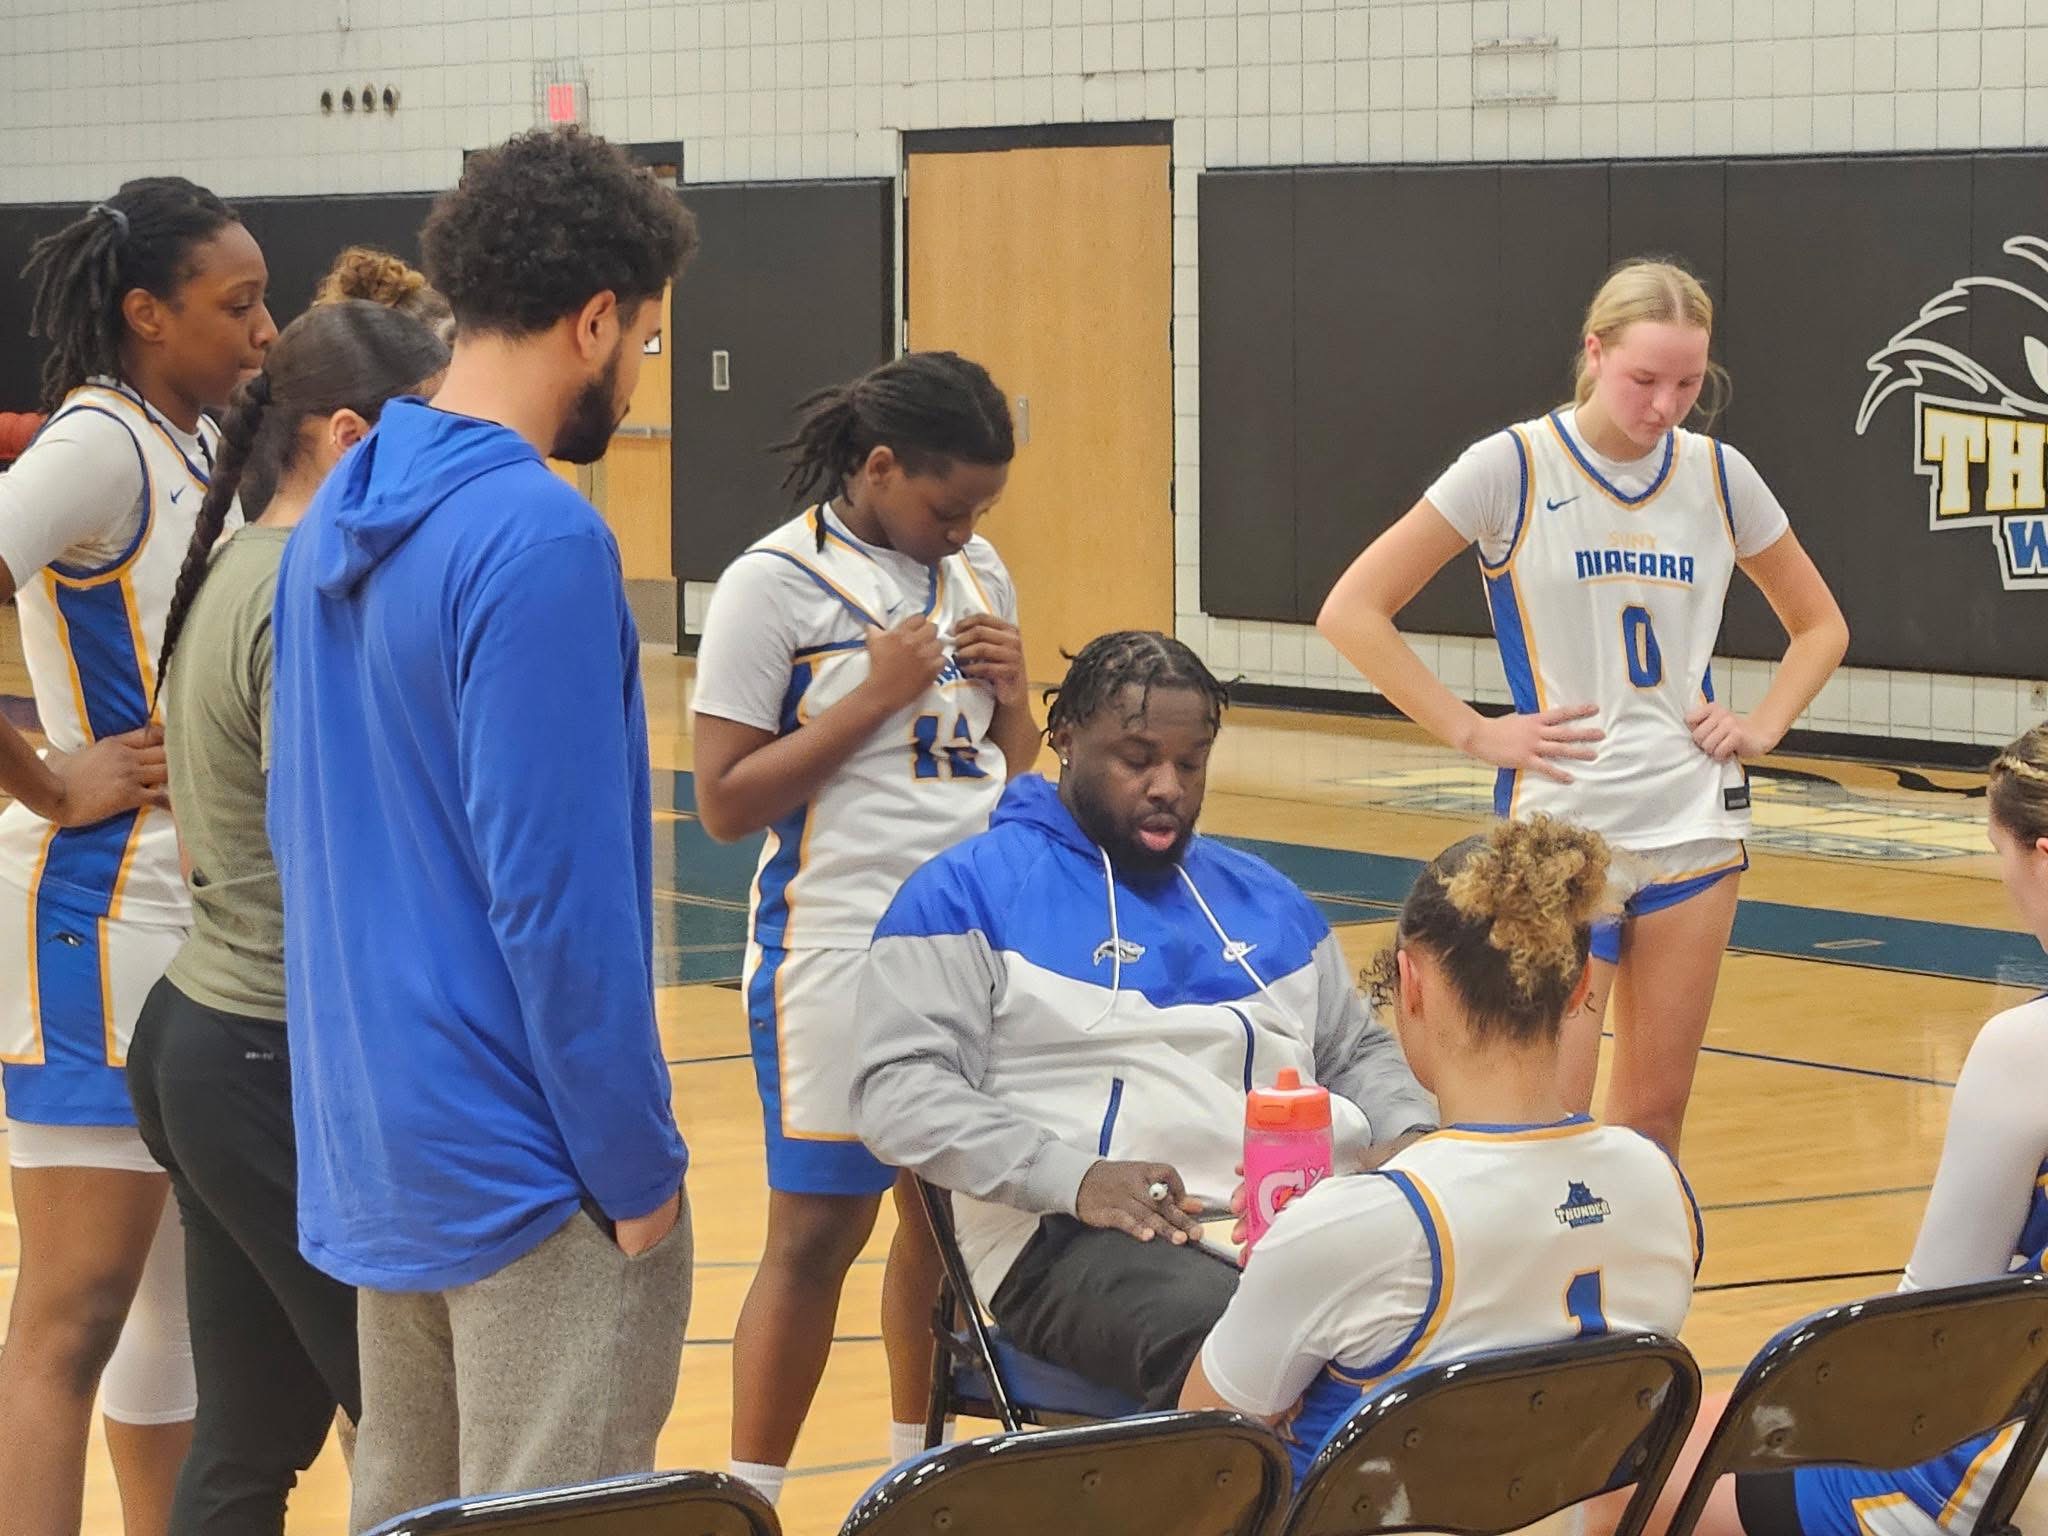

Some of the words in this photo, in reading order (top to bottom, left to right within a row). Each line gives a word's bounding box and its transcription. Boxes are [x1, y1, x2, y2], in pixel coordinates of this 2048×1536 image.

[1923, 407, 2048, 516] TH
[1575, 549, 1694, 584] NIAGARA
[1620, 604, 1664, 690] 0
[1555, 1201, 1611, 1224] THUNDER
[1564, 1267, 1610, 1337] 1
